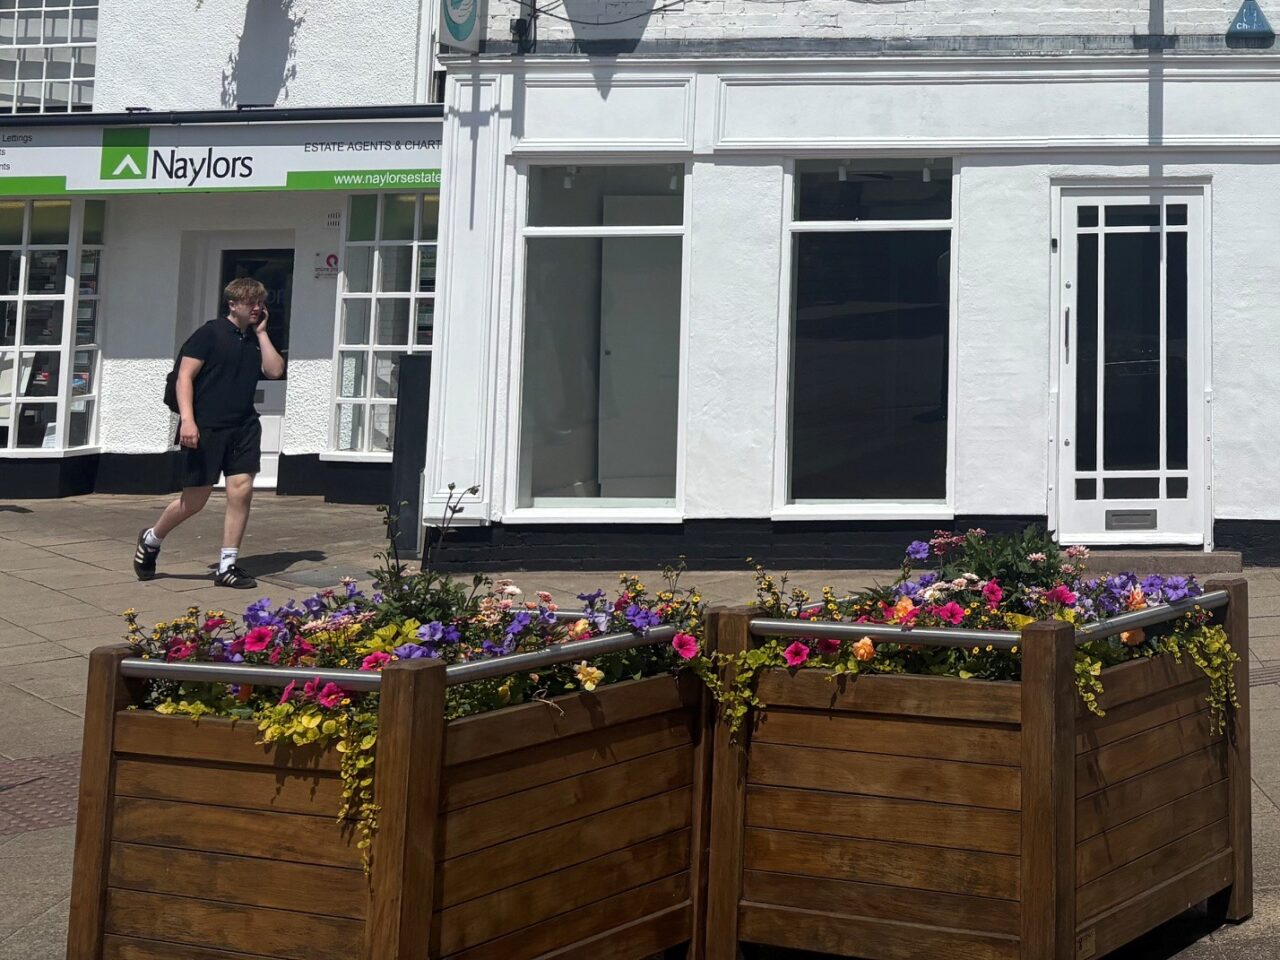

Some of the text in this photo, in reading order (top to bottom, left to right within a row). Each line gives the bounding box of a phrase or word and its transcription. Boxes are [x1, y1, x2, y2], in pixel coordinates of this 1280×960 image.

[304, 142, 344, 152] ESTATE
[347, 141, 392, 152] AGENTS
[394, 140, 401, 150] &
[151, 148, 253, 187] Naylors
